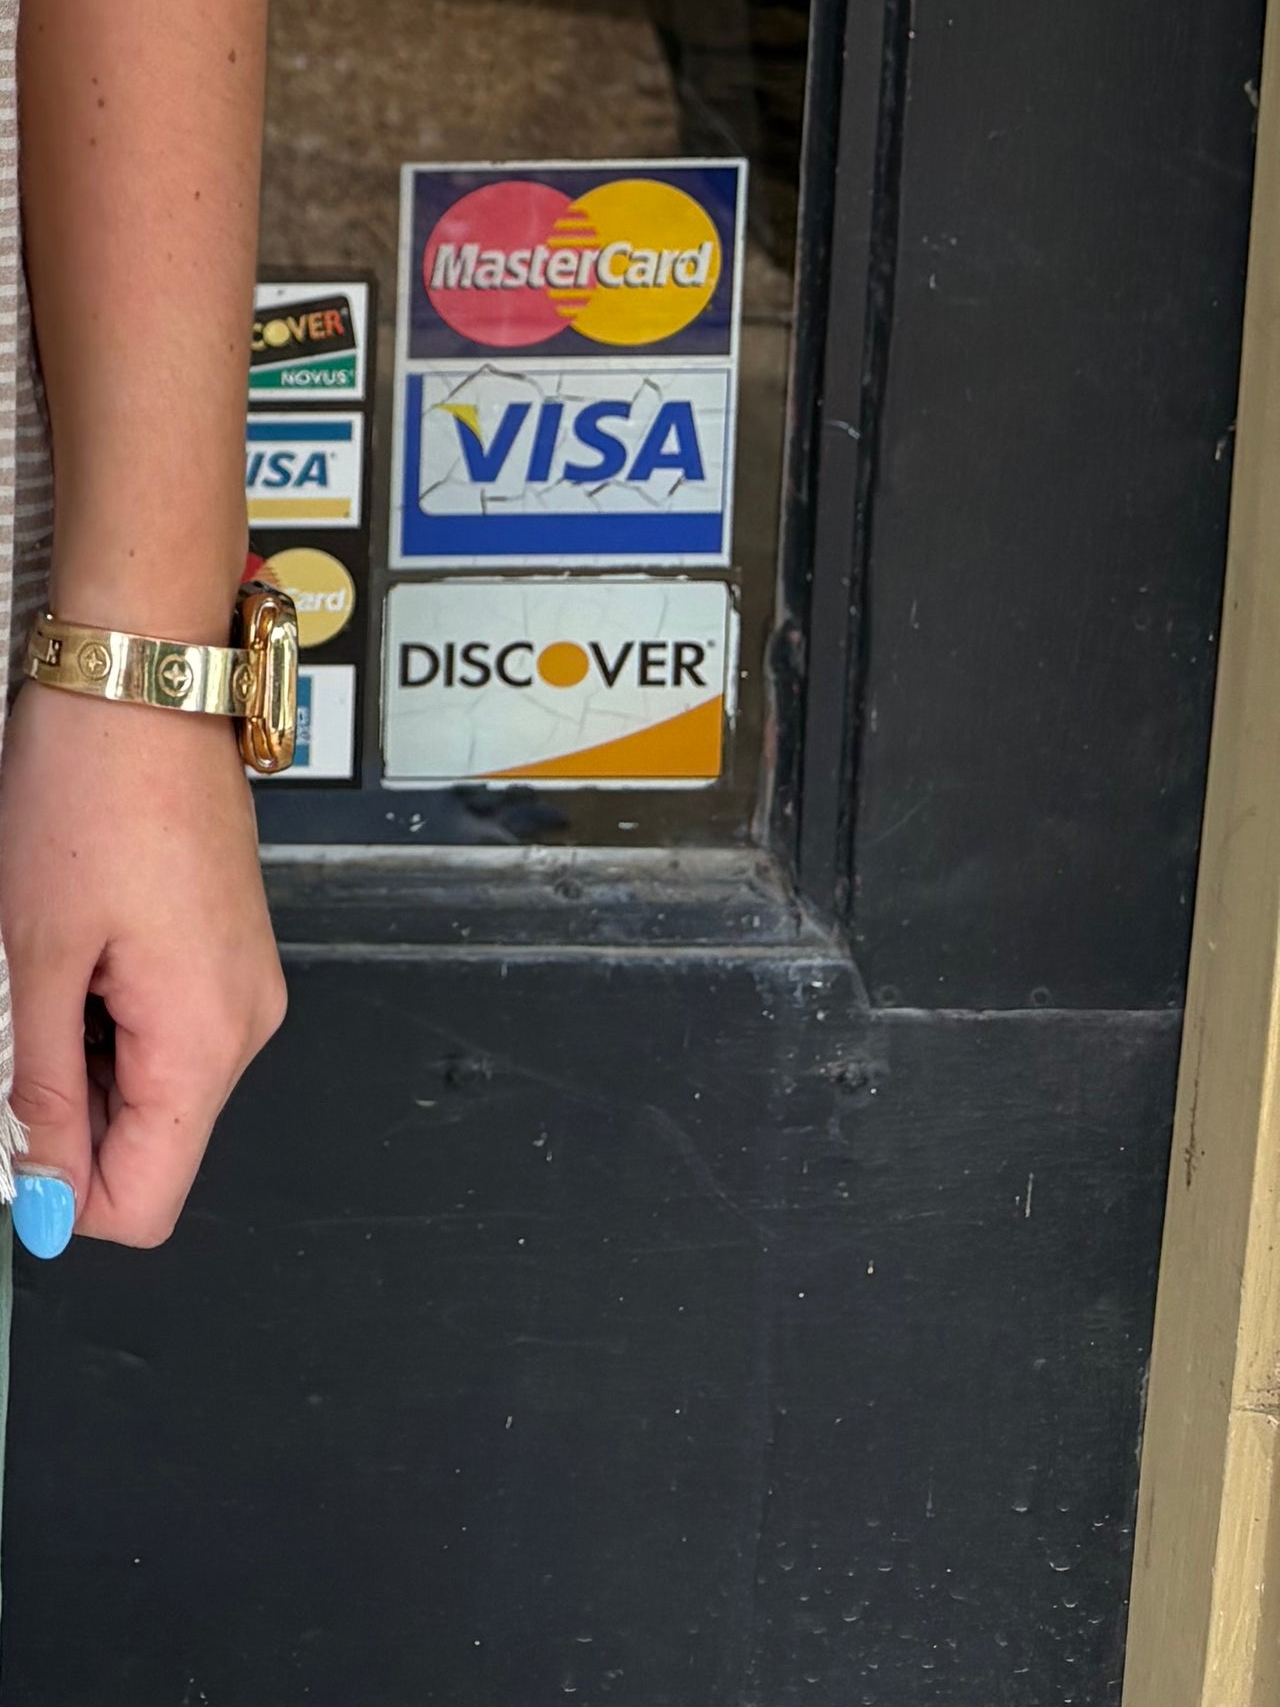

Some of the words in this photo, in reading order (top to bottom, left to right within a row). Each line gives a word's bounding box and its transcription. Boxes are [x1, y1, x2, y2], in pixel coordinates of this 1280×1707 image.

[430, 240, 717, 290] MasterCard
[250, 309, 345, 351] COVER
[281, 369, 348, 386] NOVUS
[440, 400, 706, 483] VISA
[246, 451, 329, 488] ISA
[399, 640, 707, 688] DISCOVER
